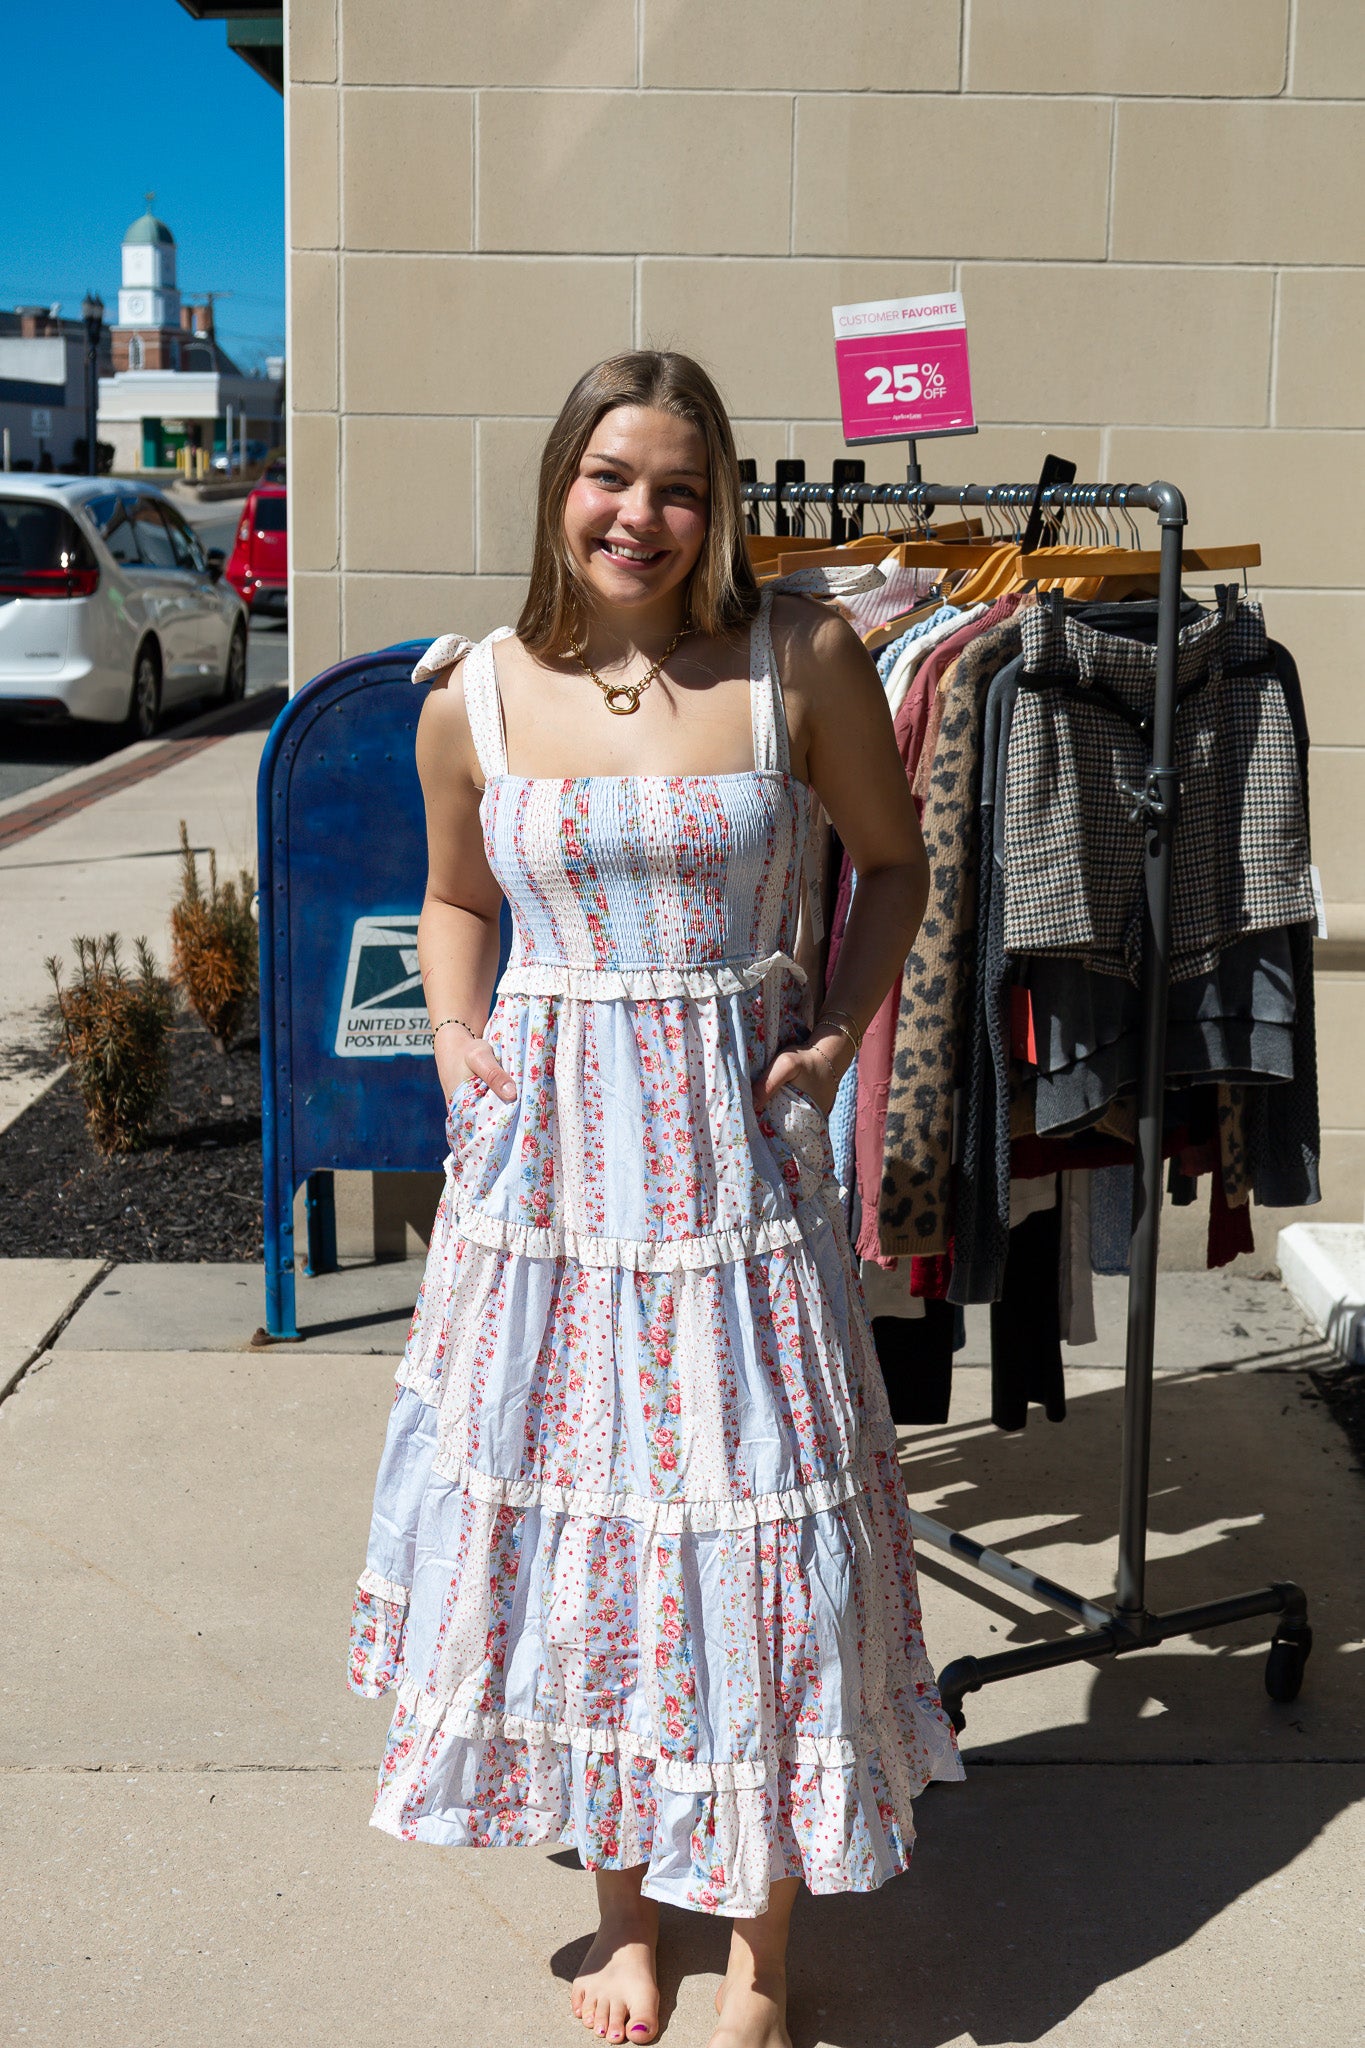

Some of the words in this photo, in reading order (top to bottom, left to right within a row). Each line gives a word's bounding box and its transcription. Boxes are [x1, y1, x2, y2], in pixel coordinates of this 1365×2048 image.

[839, 311, 900, 327] CUSTOMER
[902, 303, 957, 319] FAVORITE
[864, 362, 945, 405] 25%
[923, 387, 947, 400] OFF
[347, 1018, 406, 1031] UNITED
[344, 1034, 401, 1048] POSTAL
